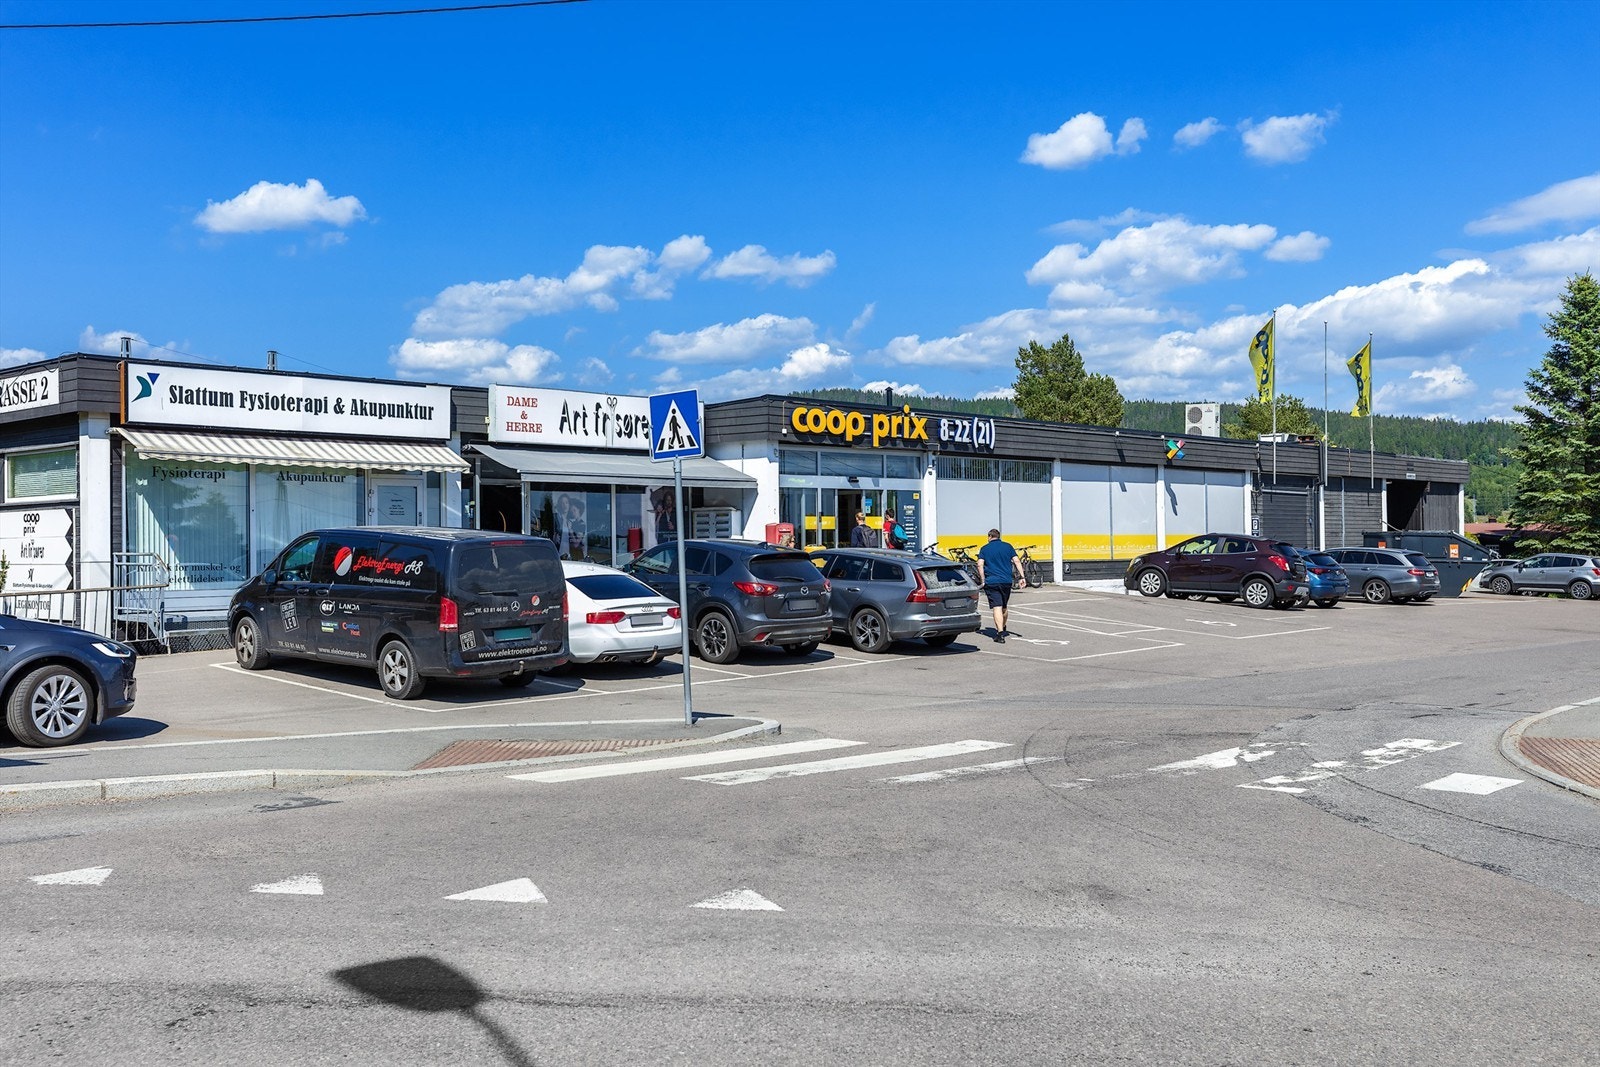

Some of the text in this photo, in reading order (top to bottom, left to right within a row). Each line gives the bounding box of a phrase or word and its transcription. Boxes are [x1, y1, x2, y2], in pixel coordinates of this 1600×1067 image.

[41, 376, 48, 400] 2
[169, 384, 434, 420] Slattum Fysioterapi & Akupunktur
[507, 396, 538, 408] DAME
[520, 410, 528, 420] &
[559, 398, 589, 436] Art
[506, 421, 543, 433] HERRE
[791, 403, 929, 447] coop prix
[940, 417, 996, 449] 8-22 (21)
[152, 465, 226, 482] Fysioterapi
[277, 471, 346, 484] Akupunktur
[23, 513, 40, 524] coop
[23, 523, 36, 536] prix
[478, 645, 548, 658] www.elektroenergi.no
